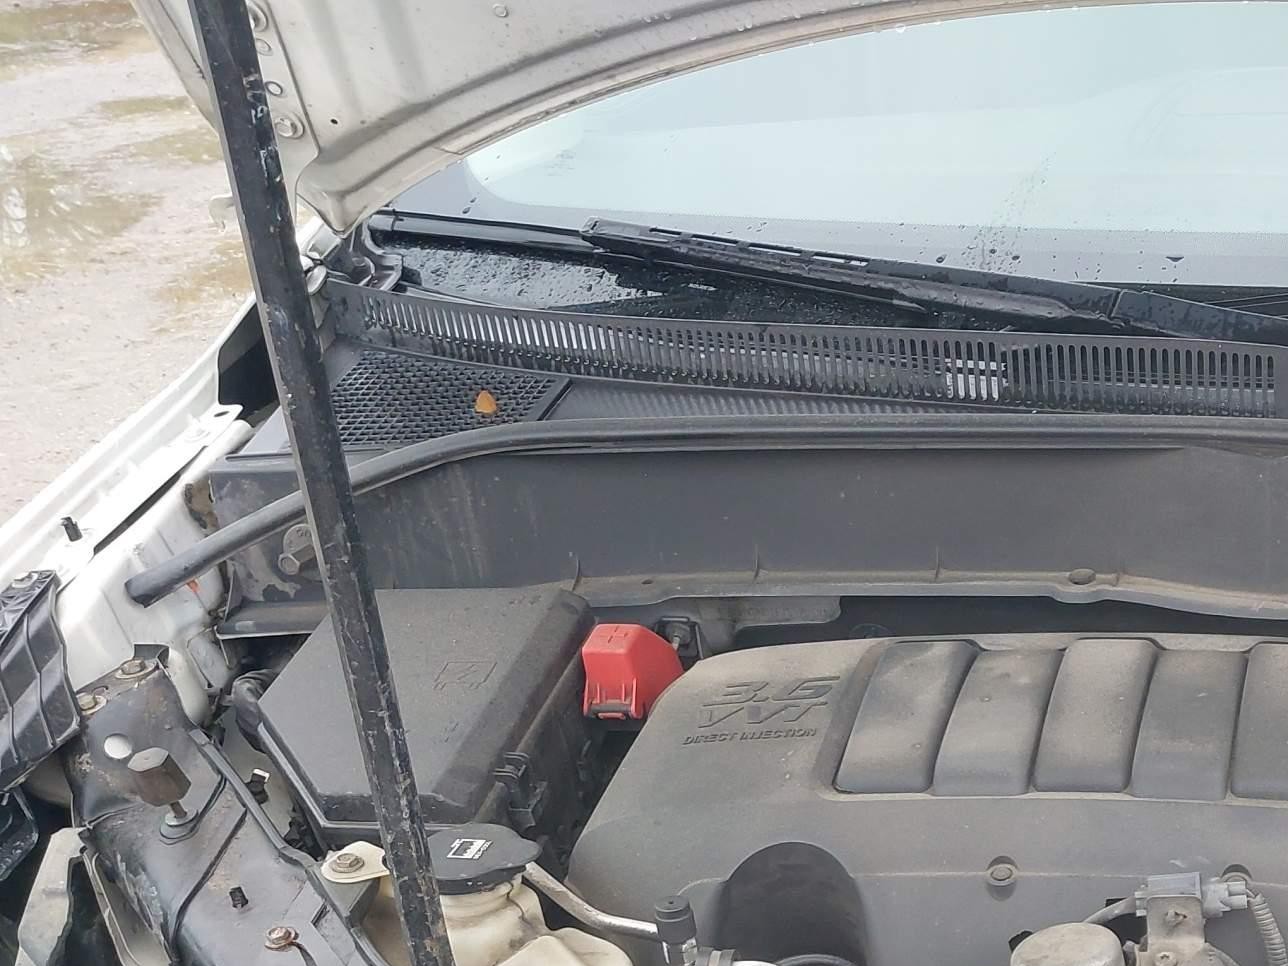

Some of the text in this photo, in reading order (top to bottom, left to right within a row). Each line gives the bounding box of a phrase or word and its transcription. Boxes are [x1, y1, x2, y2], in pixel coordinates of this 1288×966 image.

[702, 675, 841, 707] 3.6
[698, 701, 828, 729] VVT
[682, 728, 818, 746] DIRECT INJECTION
